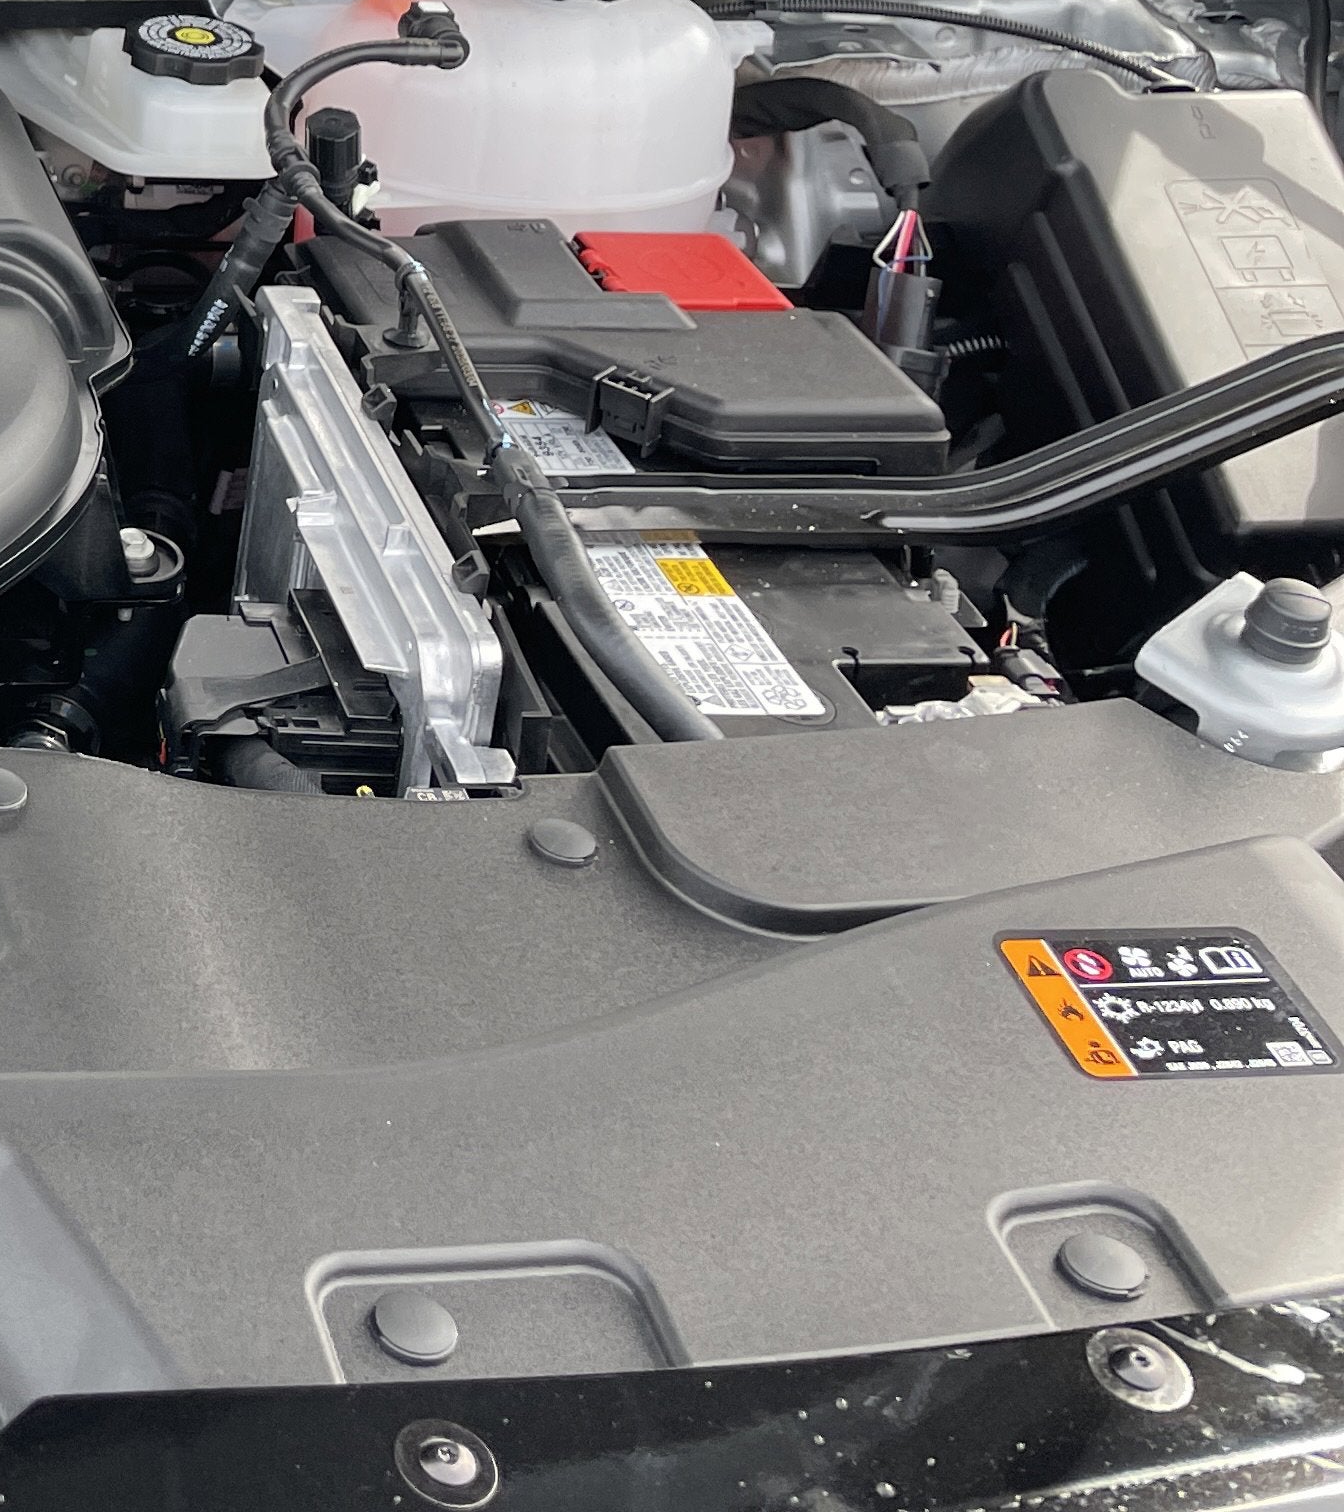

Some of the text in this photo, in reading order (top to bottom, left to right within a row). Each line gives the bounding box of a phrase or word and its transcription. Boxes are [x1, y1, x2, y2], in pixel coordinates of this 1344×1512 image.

[1129, 967, 1166, 978] AUTO
[1250, 996, 1276, 1012] kg
[1167, 1039, 1205, 1054] PAG
